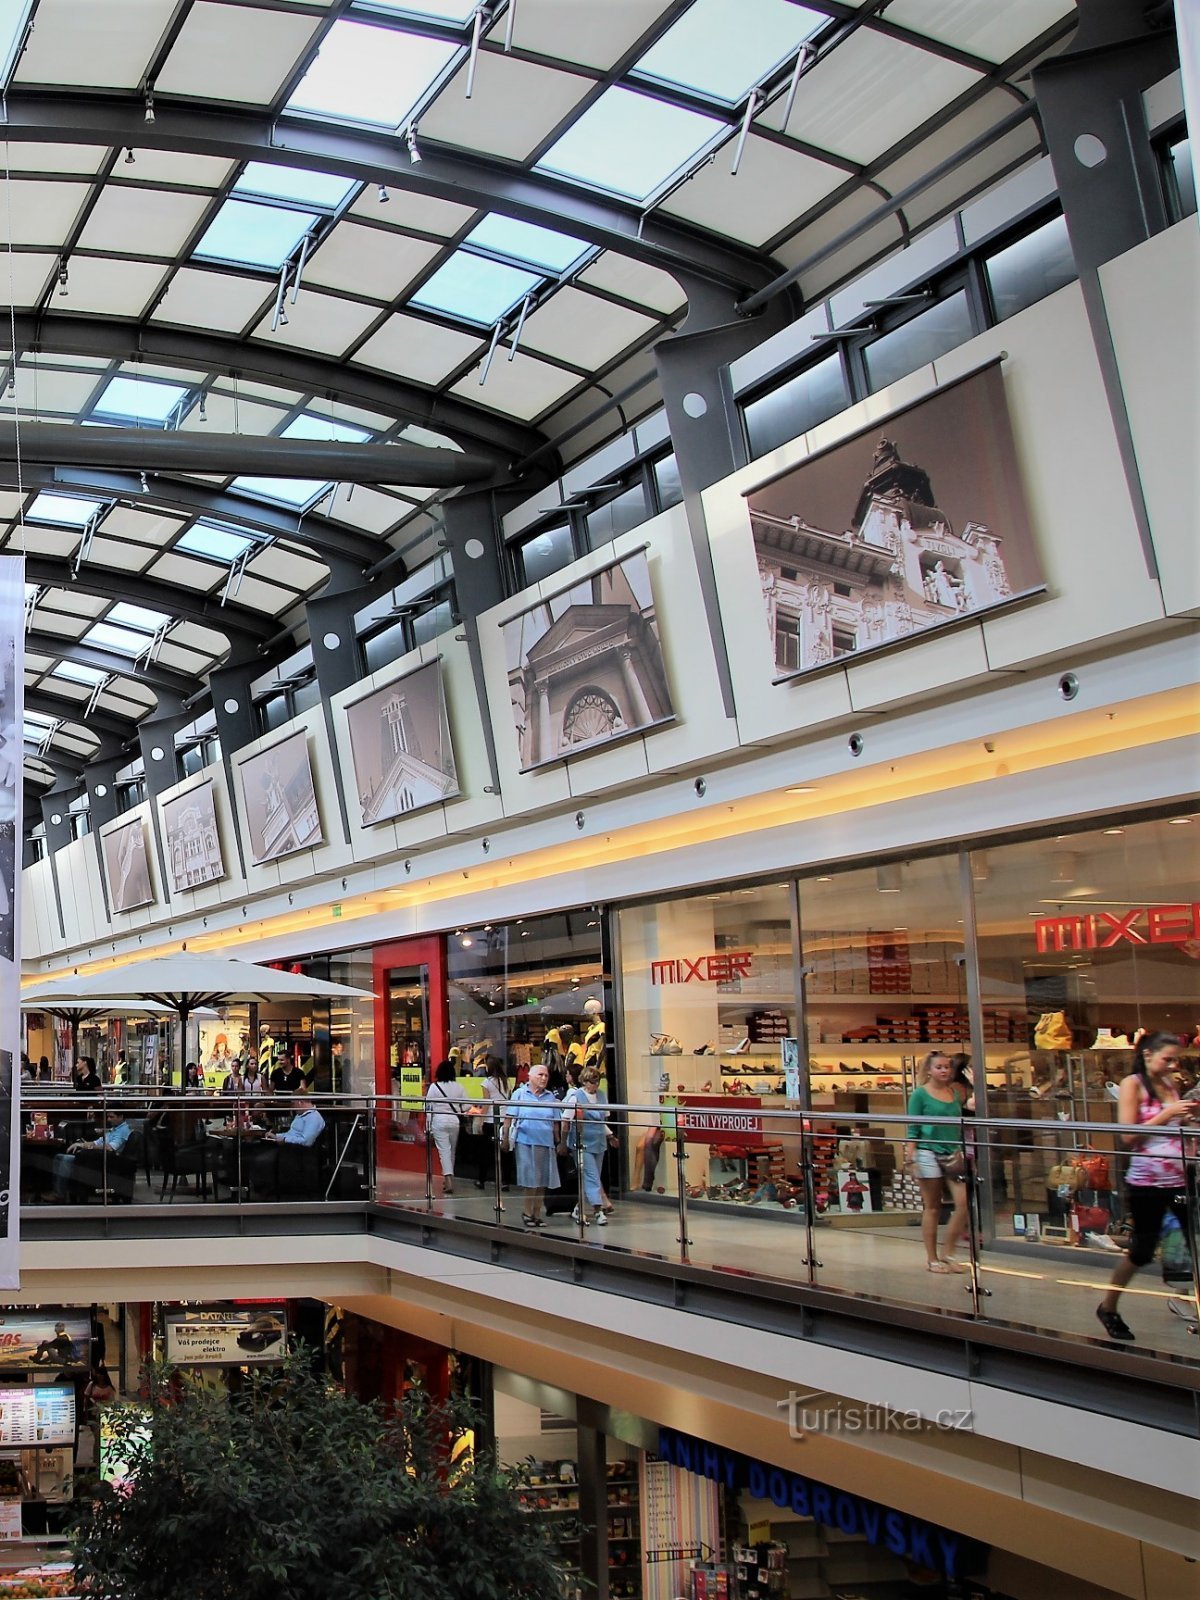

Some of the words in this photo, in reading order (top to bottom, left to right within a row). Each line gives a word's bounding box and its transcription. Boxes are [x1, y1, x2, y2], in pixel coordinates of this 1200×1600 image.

[1034, 902, 1200, 953] MIXE
[651, 952, 754, 986] MIXER
[191, 1338, 220, 1347] prodejce
[659, 1434, 736, 1489] KNIHY
